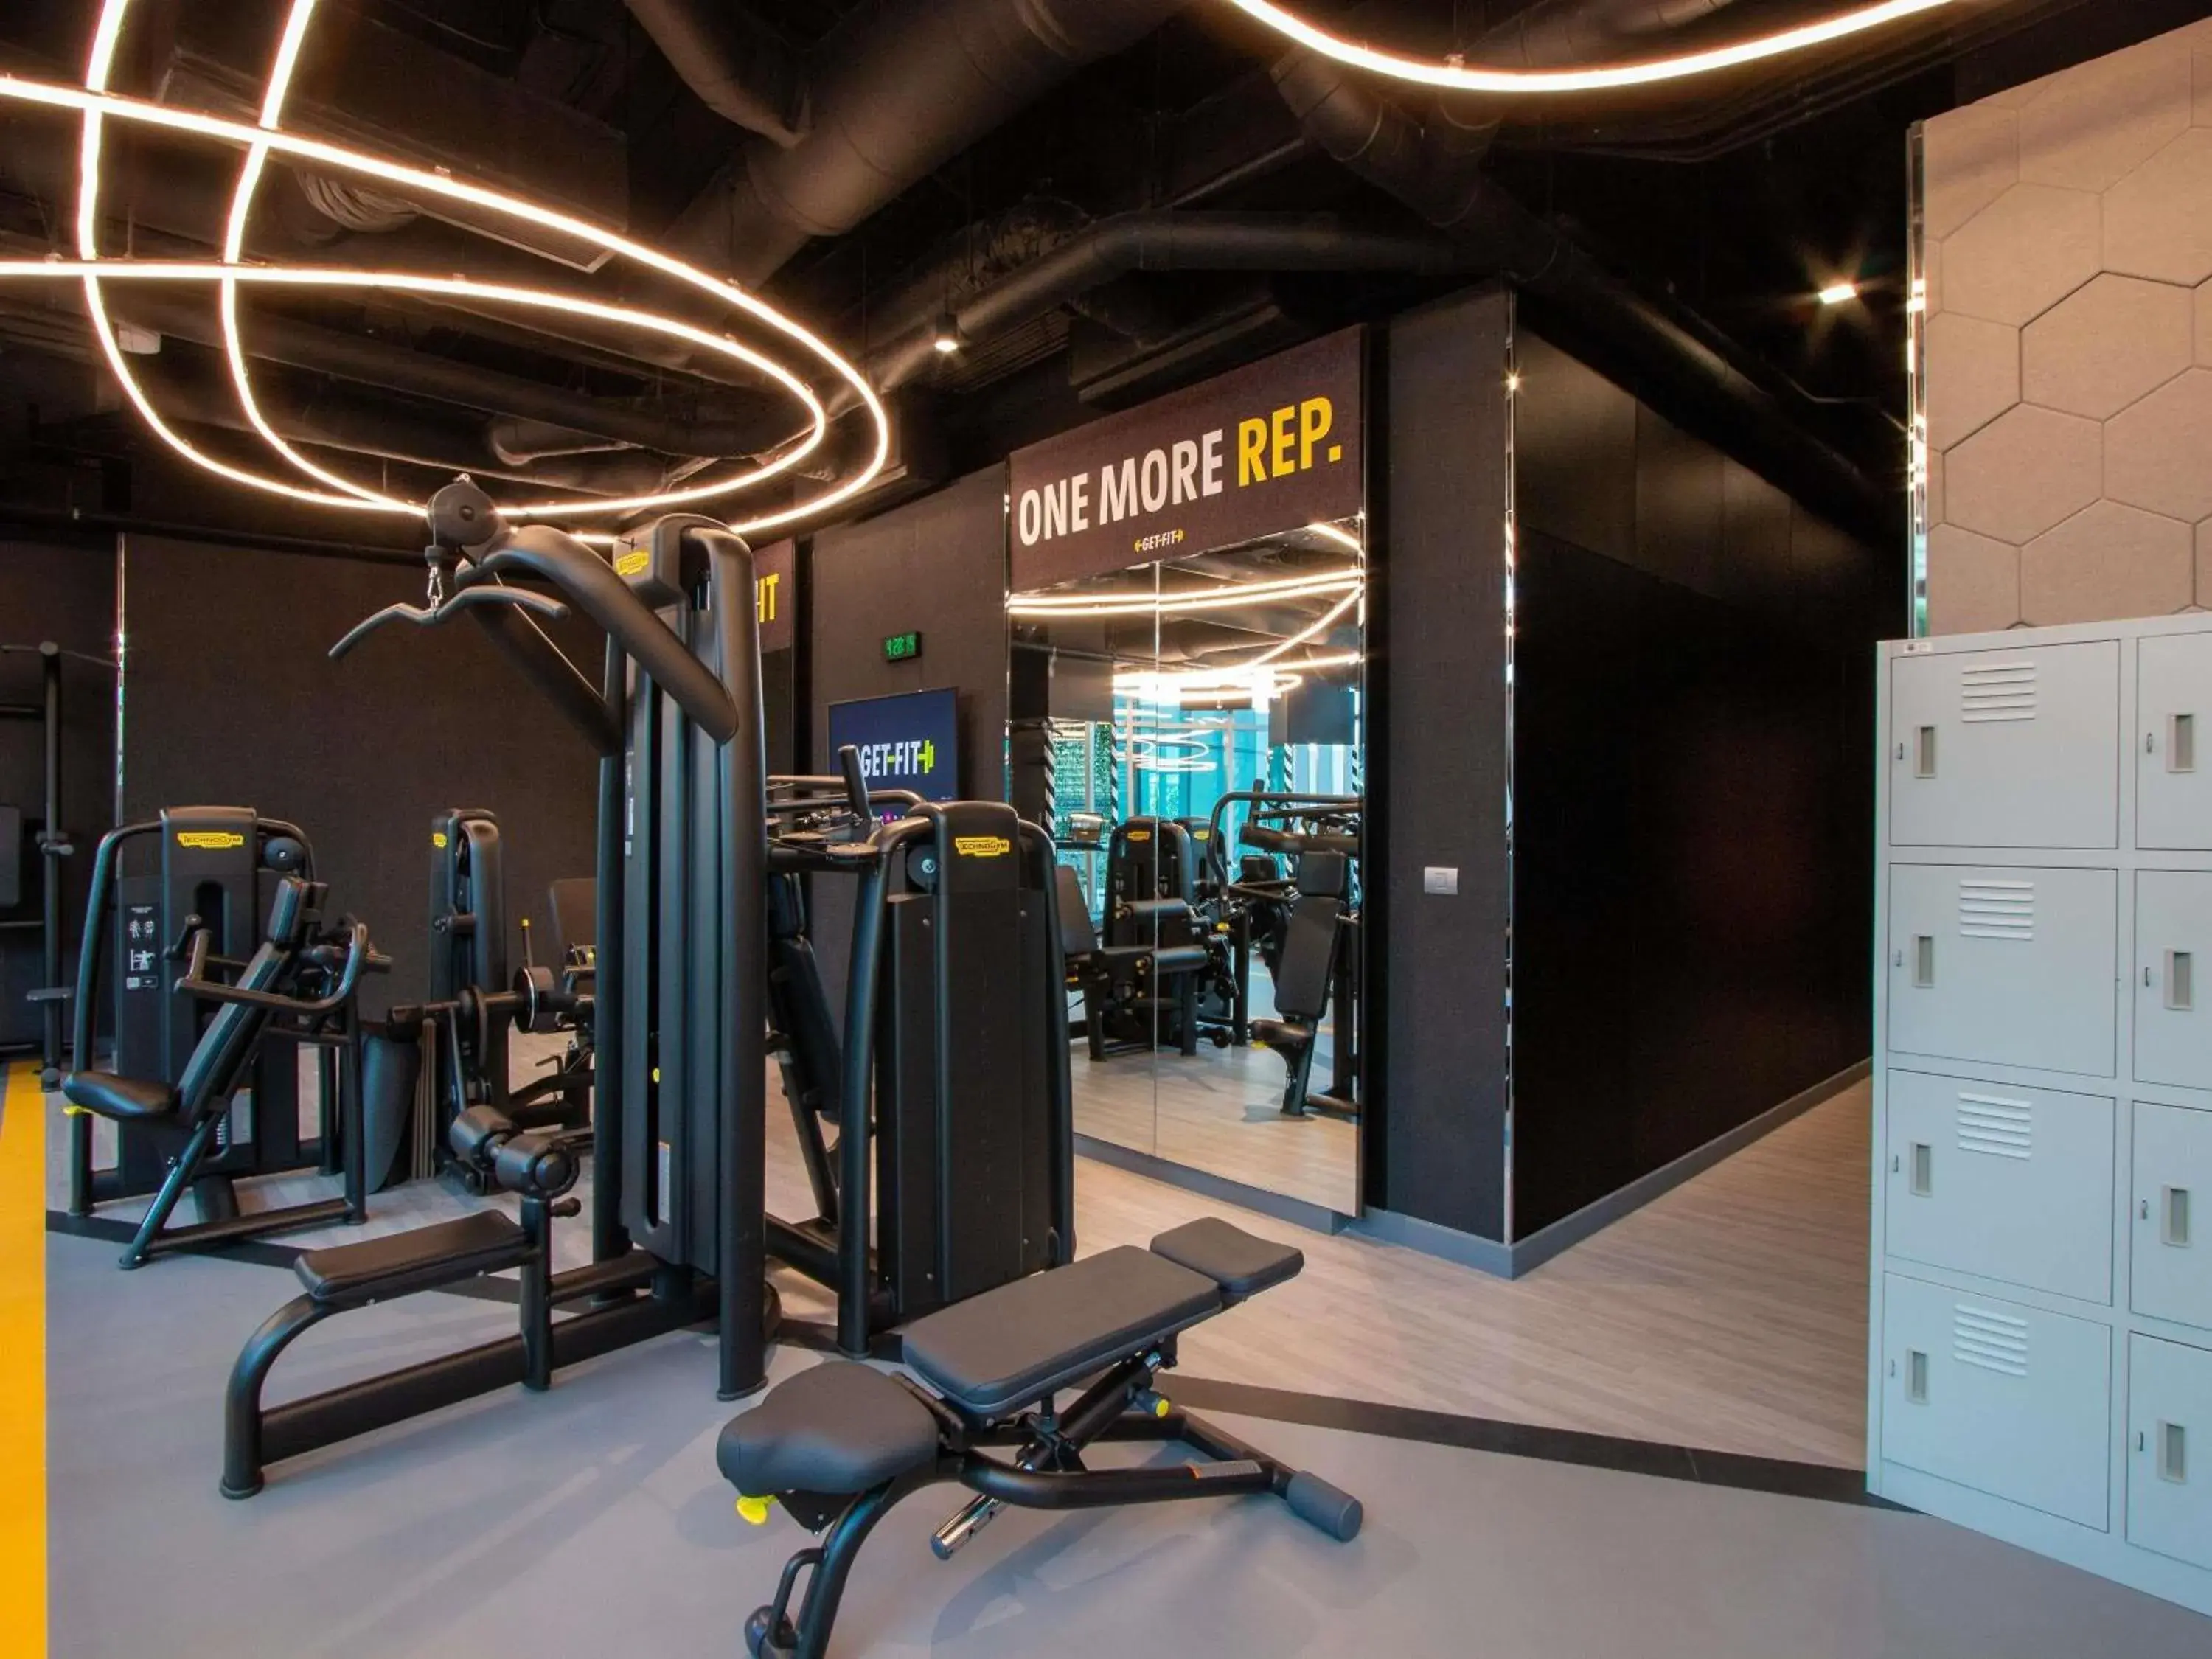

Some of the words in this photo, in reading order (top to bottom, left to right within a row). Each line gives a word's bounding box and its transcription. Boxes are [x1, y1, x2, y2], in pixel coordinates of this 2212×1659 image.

[1019, 473, 1089, 546] ONE
[1099, 428, 1223, 526] MORE
[1239, 397, 1341, 487] REP.
